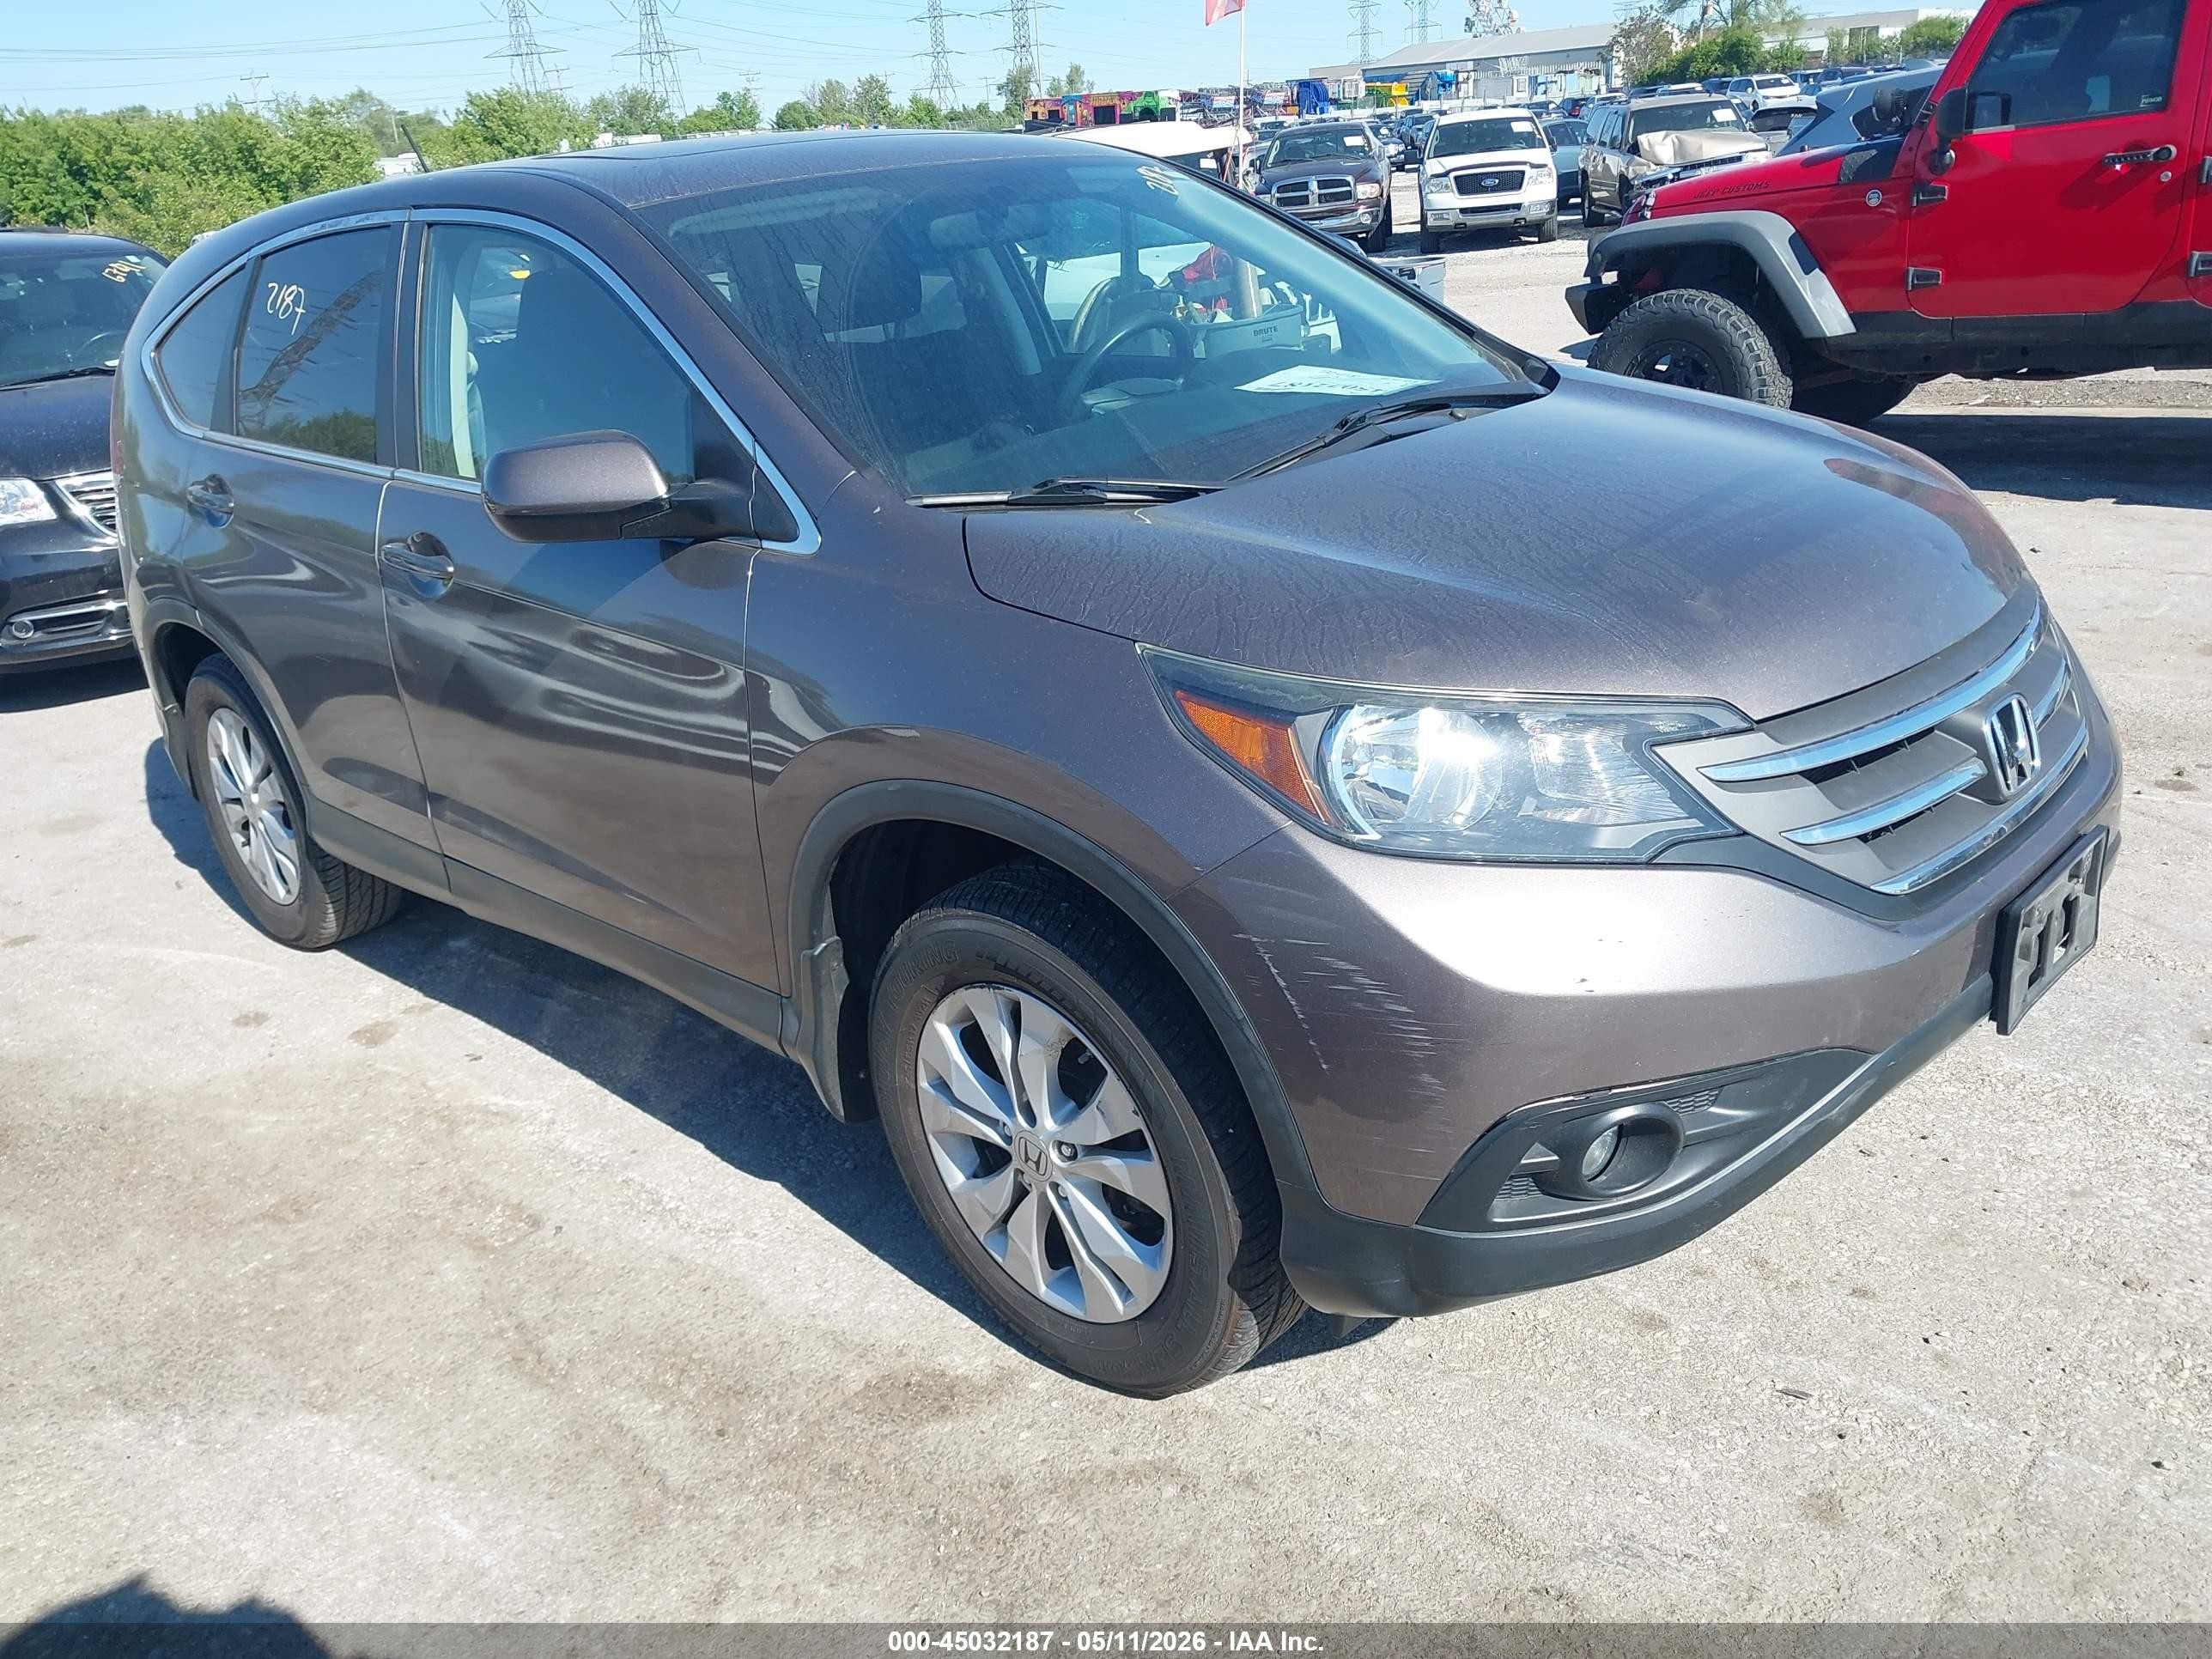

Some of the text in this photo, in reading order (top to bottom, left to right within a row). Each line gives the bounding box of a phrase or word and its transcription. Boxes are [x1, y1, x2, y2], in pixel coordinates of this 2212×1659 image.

[1721, 180, 1771, 195] CUSTOMS
[267, 282, 307, 336] 2187
[1253, 325, 1279, 337] BRUTE
[884, 939, 960, 1012] TOURING
